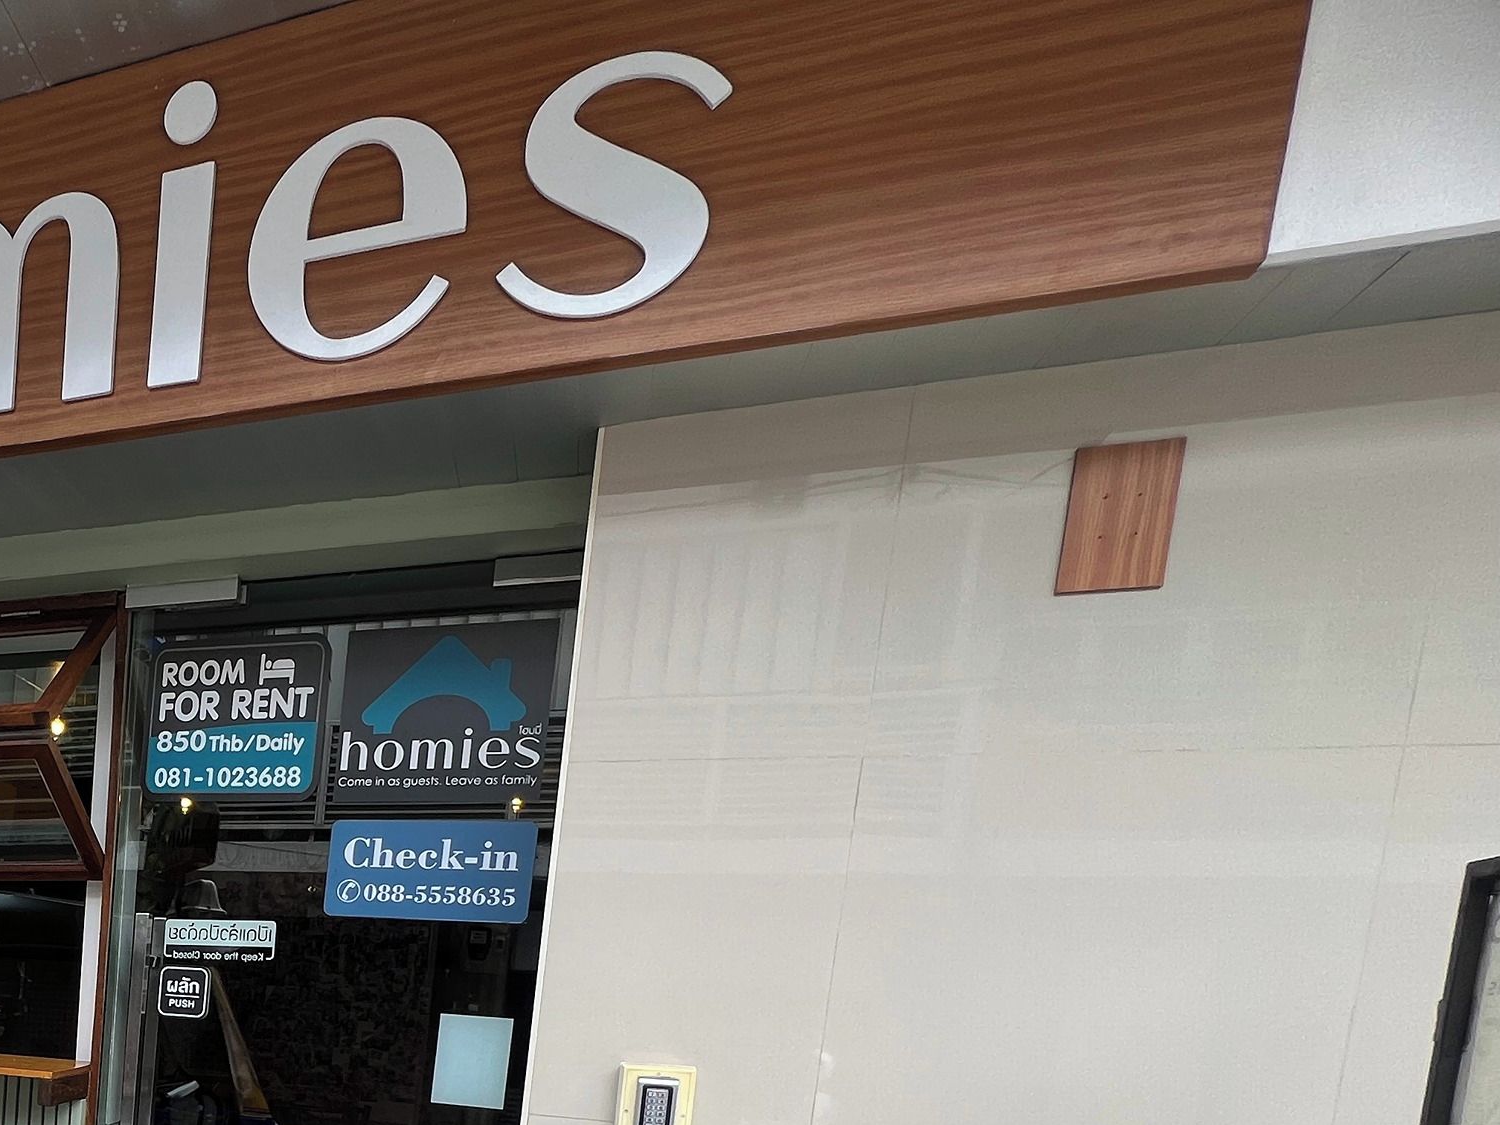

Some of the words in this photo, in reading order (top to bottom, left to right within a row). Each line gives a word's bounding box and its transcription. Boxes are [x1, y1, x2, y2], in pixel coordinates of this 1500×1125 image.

[161, 658, 245, 688] ROOM
[158, 690, 220, 722] FOR
[230, 687, 315, 720] RENT
[156, 730, 207, 753] 850
[208, 732, 306, 756] Thb/Daily
[339, 727, 542, 772] homies
[154, 766, 302, 788] 081-1023688
[338, 776, 373, 788] Come
[375, 776, 385, 787] in
[387, 777, 401, 787] as
[403, 776, 442, 789] guests.
[445, 776, 482, 787] Leave
[484, 776, 499, 786] as
[501, 774, 538, 787] family
[344, 836, 519, 872] Check-in
[363, 883, 517, 907] 088-5558635
[166, 976, 200, 994] ผลัก
[168, 998, 196, 1009] PUSH
